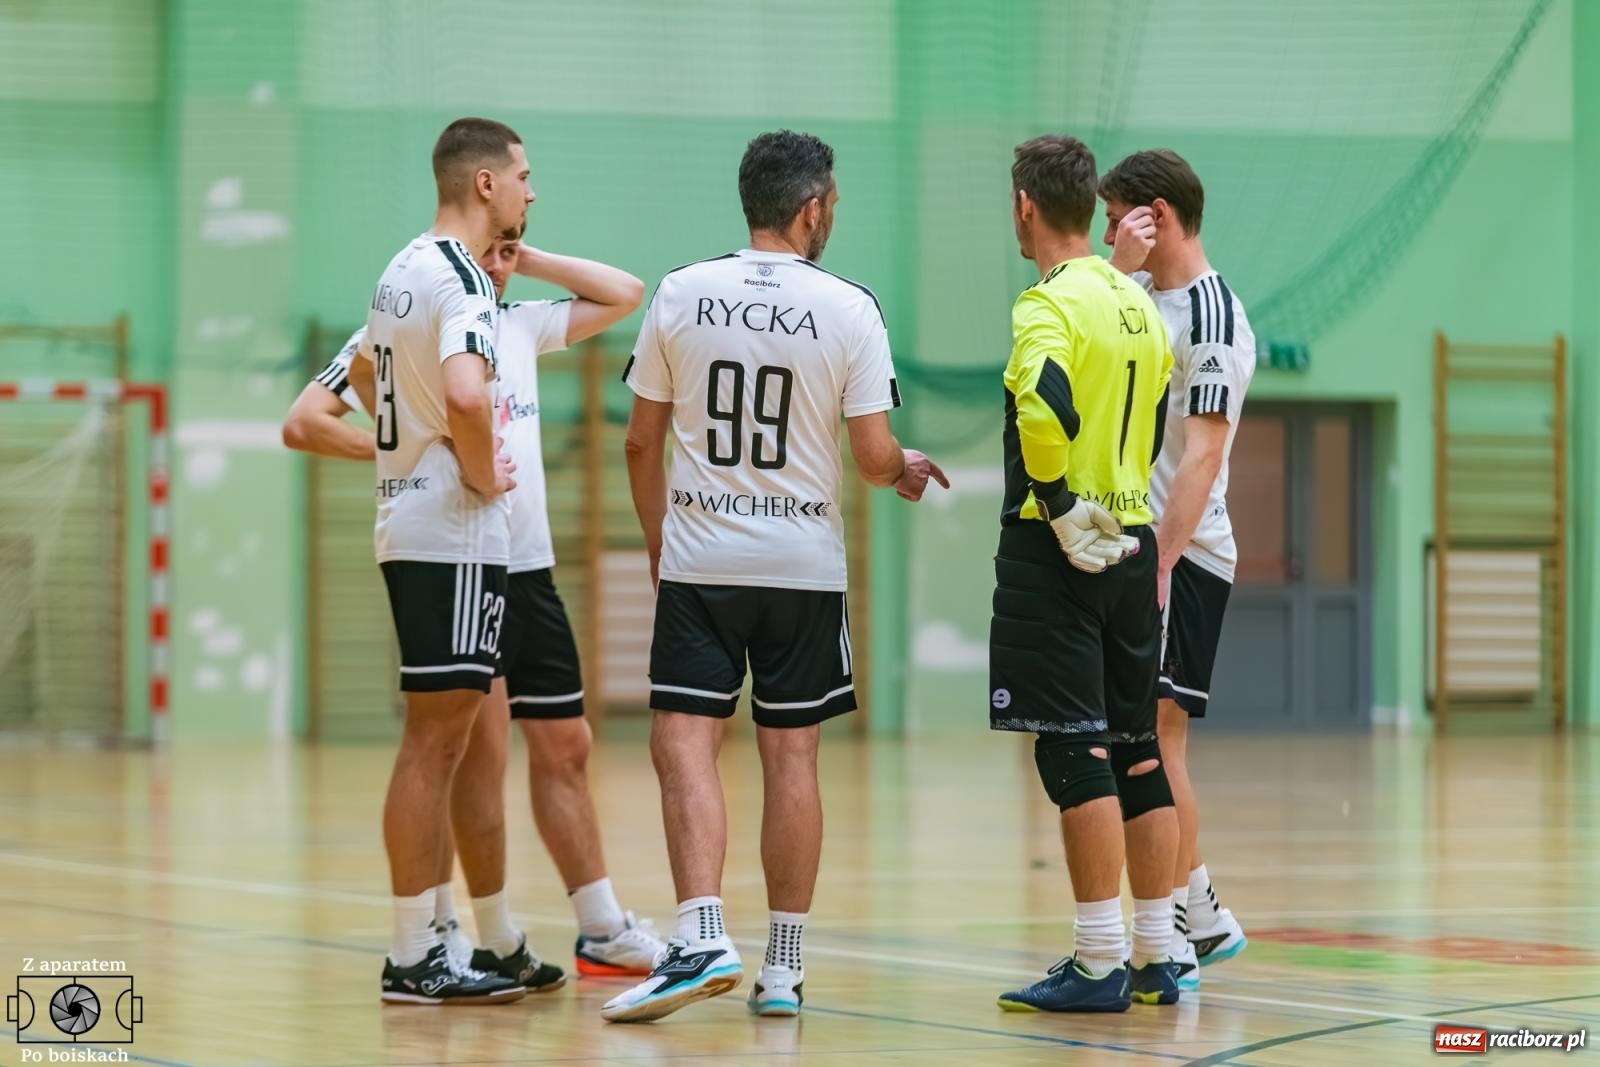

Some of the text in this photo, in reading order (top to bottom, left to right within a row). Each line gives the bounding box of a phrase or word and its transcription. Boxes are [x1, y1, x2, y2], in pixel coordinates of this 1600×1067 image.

[744, 279, 781, 288] Racibórz
[697, 297, 819, 340] RYCKA
[1119, 307, 1148, 334] ADI
[1199, 366, 1224, 374] adidas
[707, 359, 794, 470] 99
[1119, 360, 1137, 467] 1
[698, 491, 798, 517] WICHER
[478, 591, 505, 655] 23
